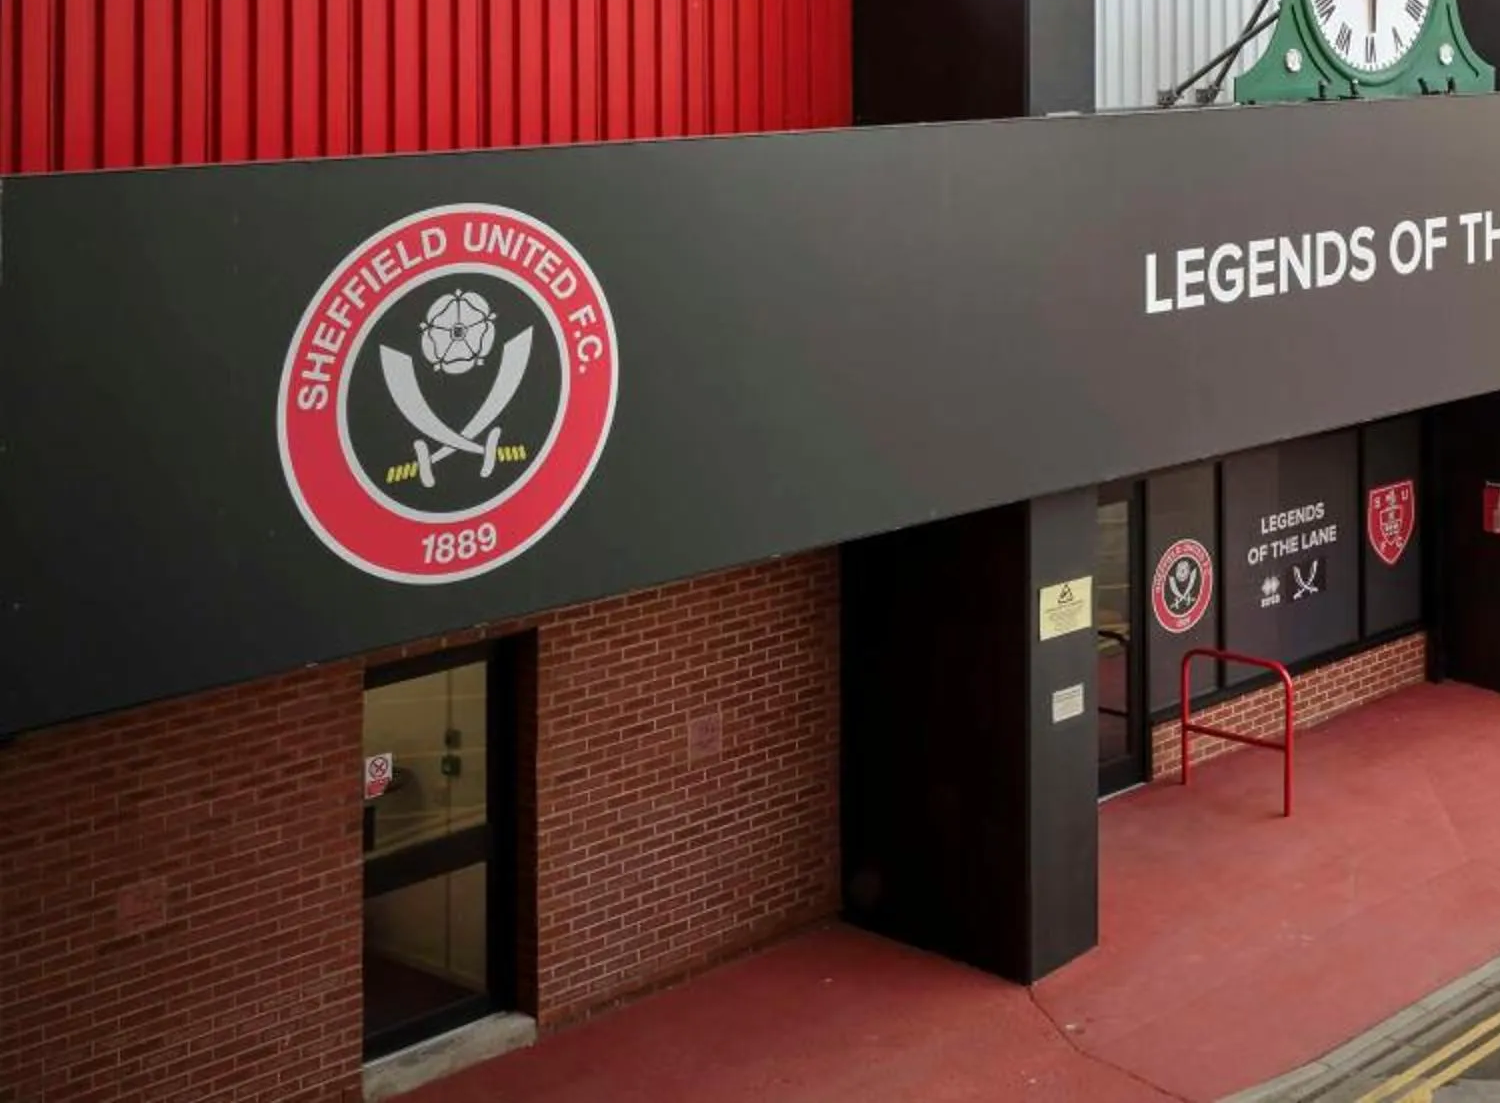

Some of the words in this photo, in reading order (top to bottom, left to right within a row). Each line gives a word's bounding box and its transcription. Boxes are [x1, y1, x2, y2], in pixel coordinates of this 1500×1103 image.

[1365, 36, 1377, 63] VI
[1392, 26, 1404, 53] V
[1145, 226, 1376, 314] LEGENDS
[1389, 217, 1448, 274] OF
[297, 227, 448, 410] SHEFFIELD
[463, 221, 578, 301] UNITED
[569, 305, 603, 375] F.C.
[1261, 502, 1325, 534] LEGENDS
[421, 523, 497, 564] 1889
[1247, 546, 1268, 565] OF
[1270, 537, 1298, 558] THE
[1301, 524, 1337, 549] LANE
